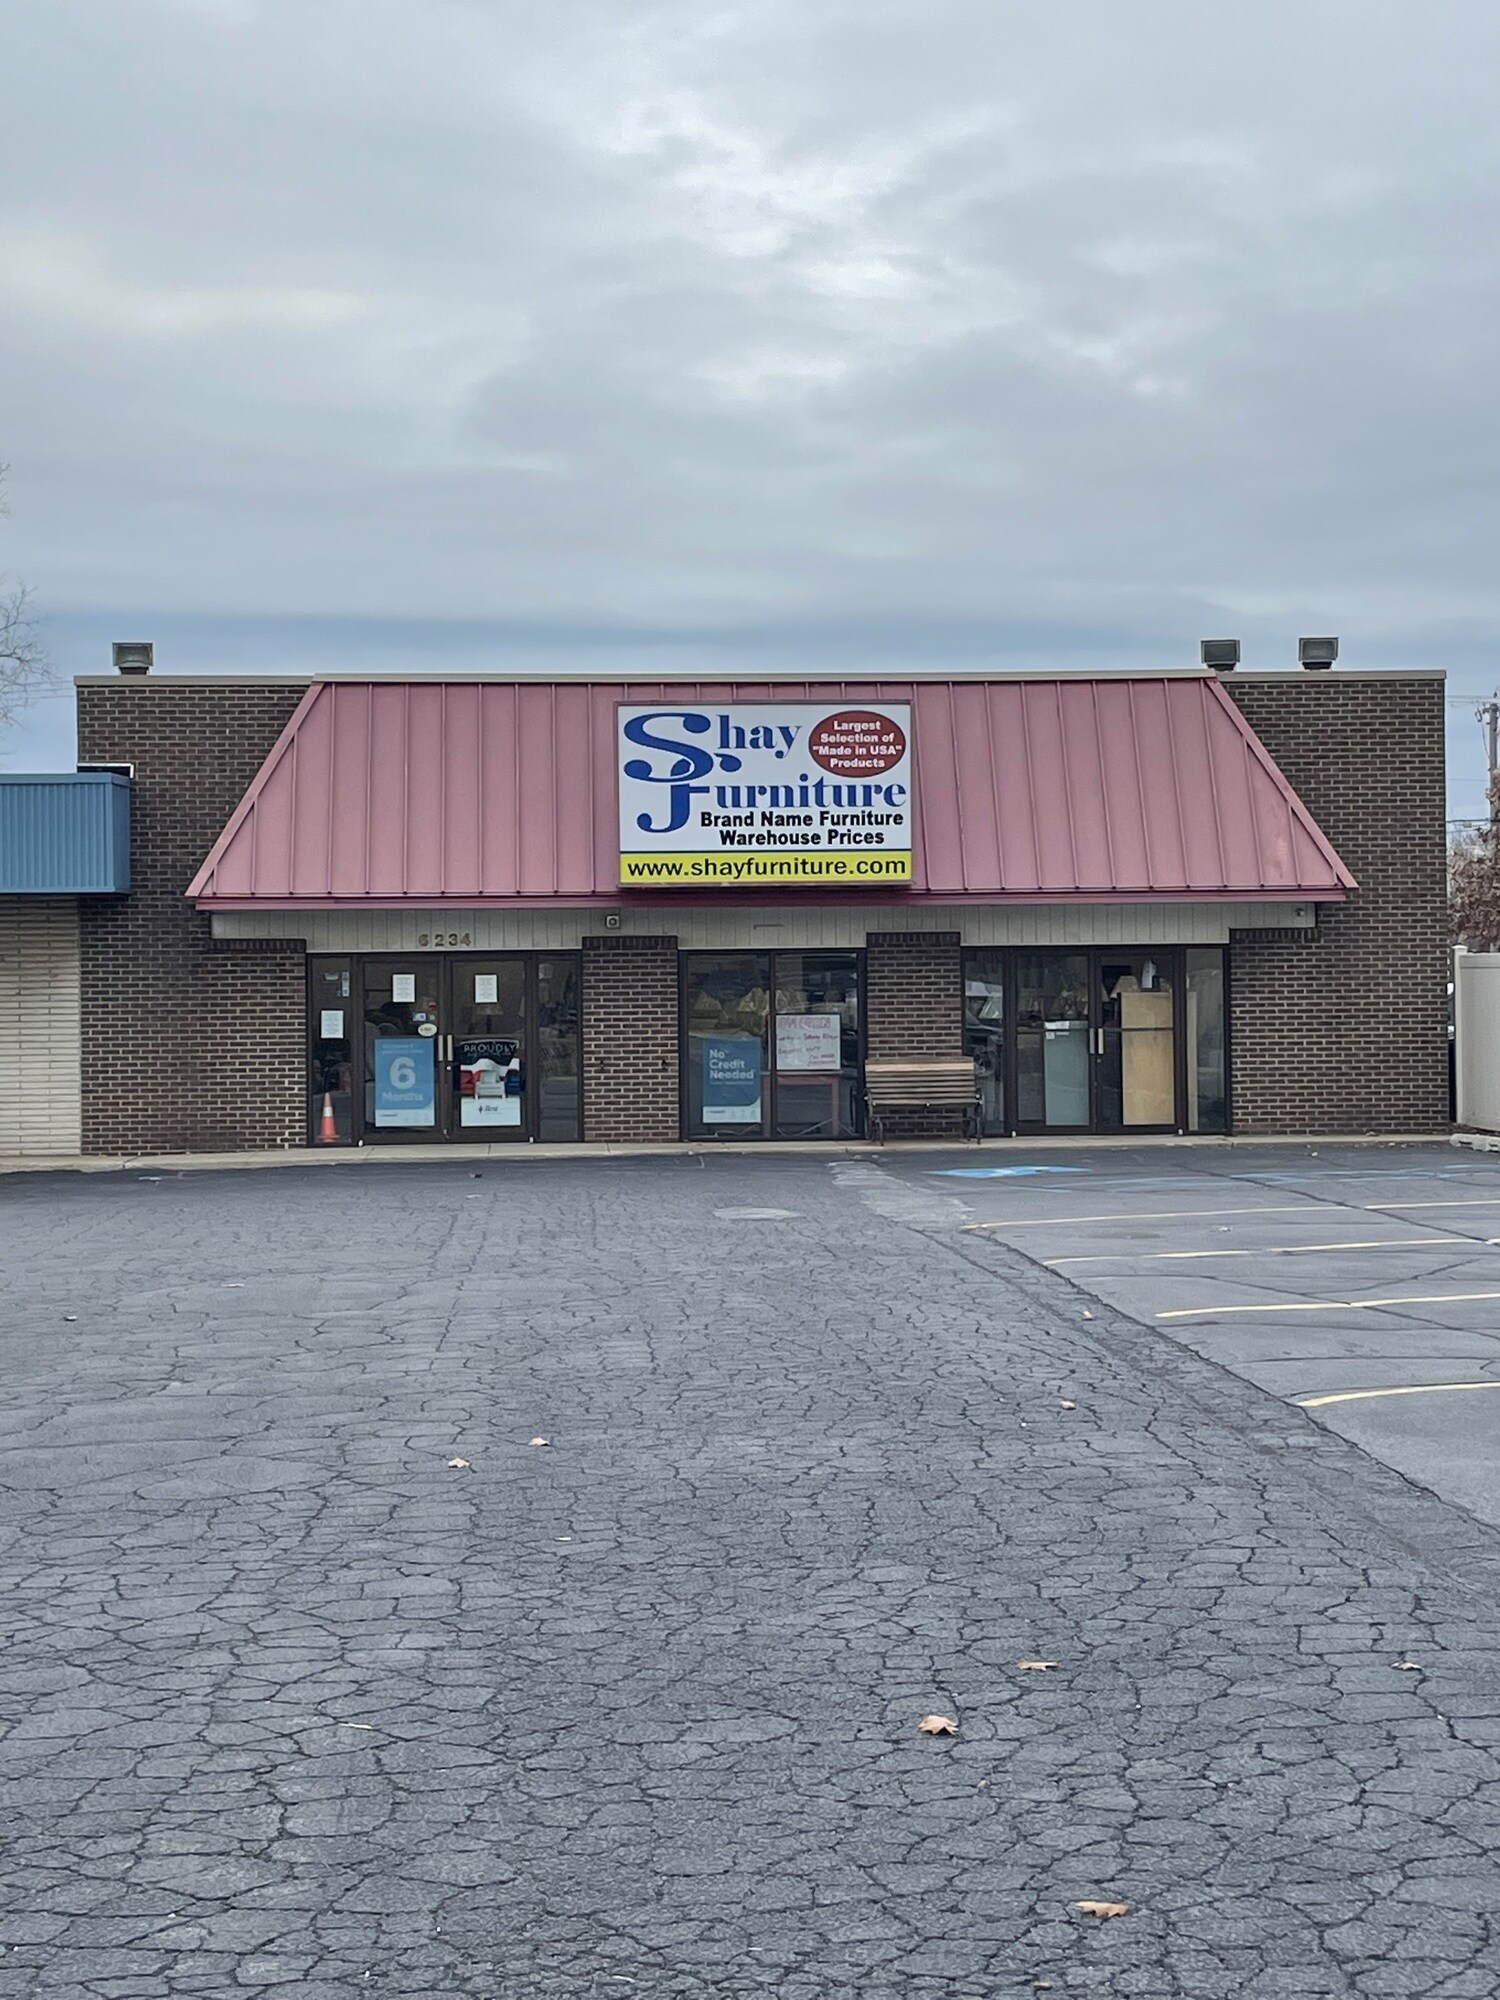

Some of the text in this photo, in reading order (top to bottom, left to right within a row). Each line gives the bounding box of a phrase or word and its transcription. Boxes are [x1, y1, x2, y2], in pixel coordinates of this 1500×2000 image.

[833, 720, 881, 732] Largest
[820, 733, 895, 743] Selection of
[623, 712, 801, 783] Shay
[812, 745, 902, 755] "Made in USA"
[830, 758, 886, 768] Products
[636, 753, 907, 833] Furniture
[700, 810, 904, 828] Brand Name Furniture
[719, 828, 885, 846] Warehouse Prices
[627, 857, 906, 879] www.shayfurniture.com
[418, 932, 471, 948] 6234
[463, 1043, 516, 1053] PROUDLY
[709, 1048, 726, 1059] No
[709, 1059, 746, 1069] Credit
[390, 1056, 416, 1090] 6
[709, 1069, 755, 1079] Needed
